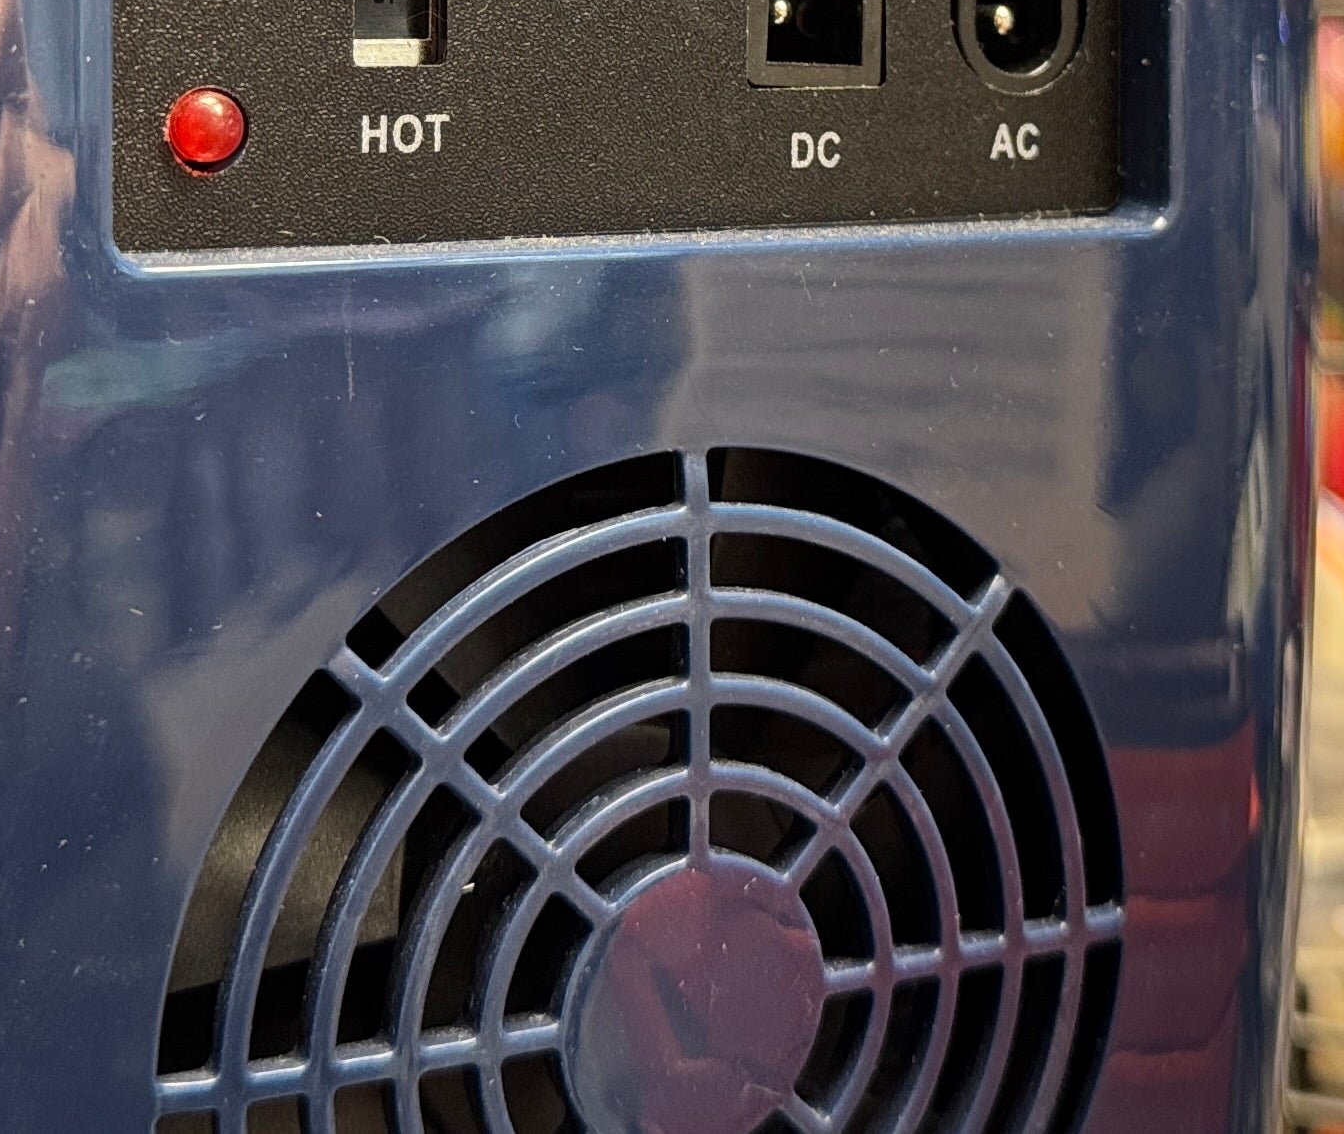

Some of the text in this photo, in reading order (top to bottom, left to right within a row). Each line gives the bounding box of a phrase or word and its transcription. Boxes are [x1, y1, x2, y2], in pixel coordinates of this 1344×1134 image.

[361, 114, 450, 153] HOT
[790, 131, 841, 168] DC
[989, 122, 1041, 160] AC
